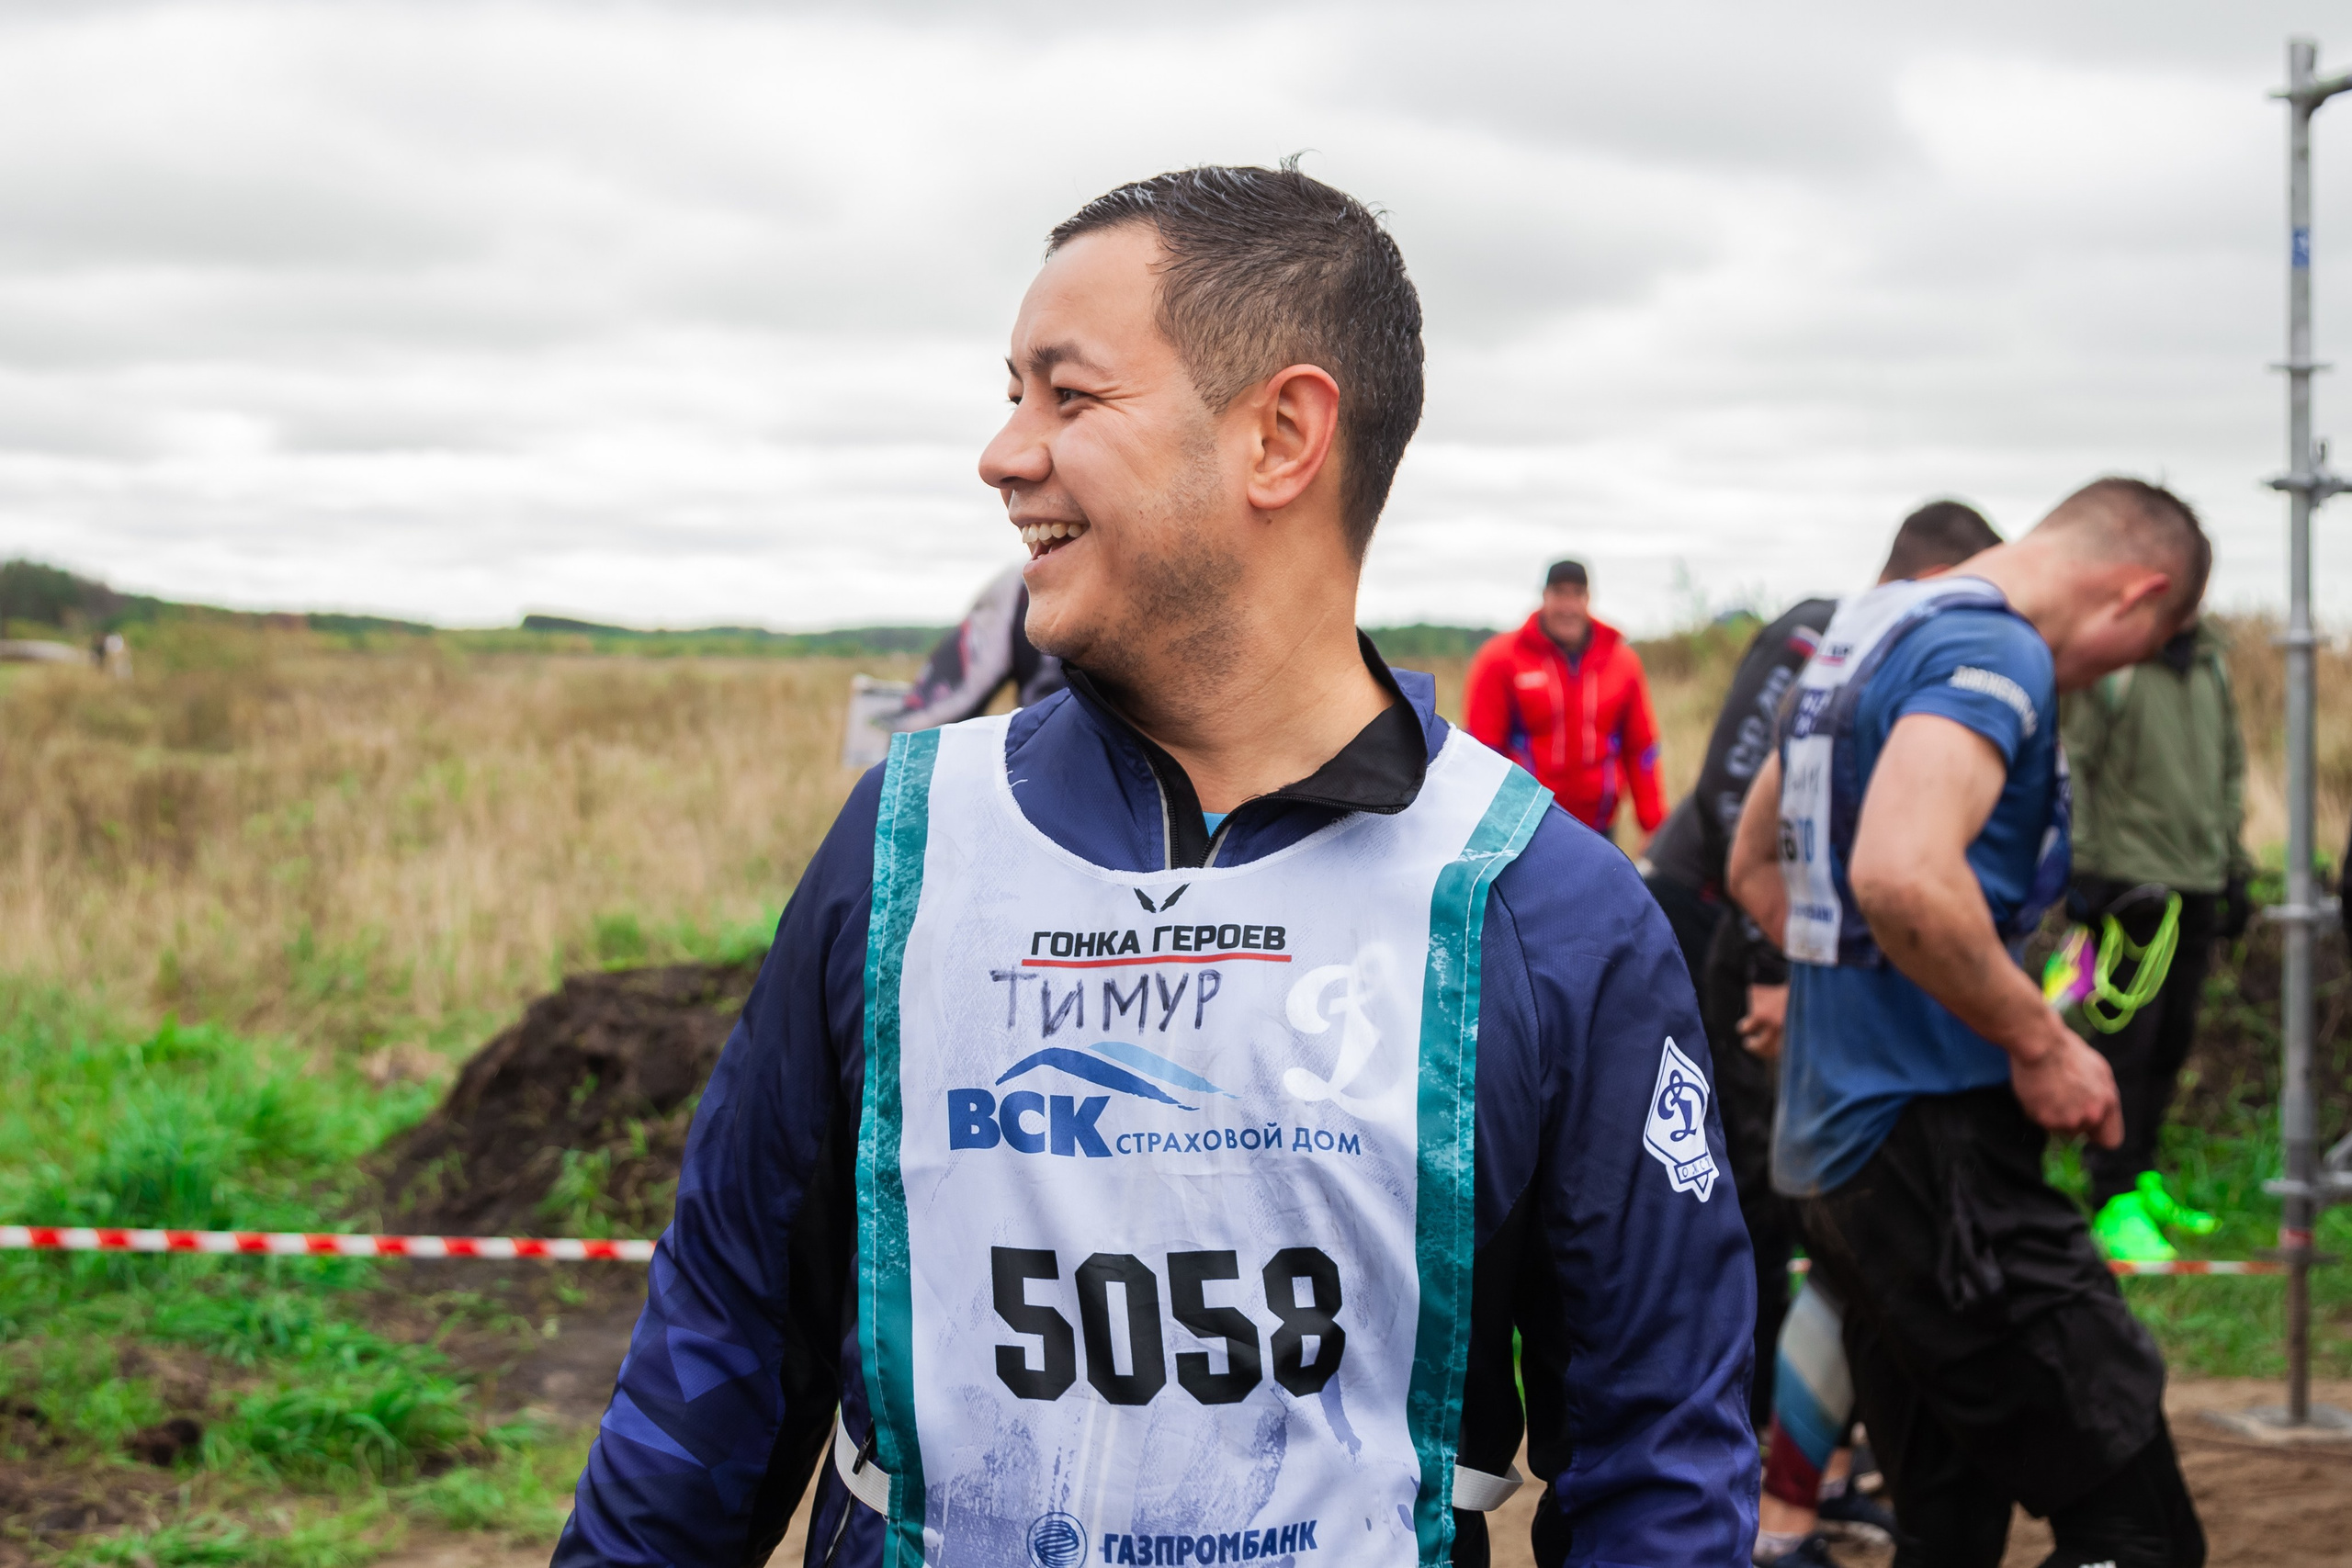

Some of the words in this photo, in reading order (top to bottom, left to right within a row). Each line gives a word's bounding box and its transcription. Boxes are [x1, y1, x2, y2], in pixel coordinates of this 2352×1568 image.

[1031, 931, 1140, 957] ГОНКА
[1152, 924, 1286, 953] ГЕРОЕВ
[990, 968, 1223, 1038] ТИМУР
[948, 1089, 1113, 1158] ВСК
[1116, 1123, 1283, 1156] СТРАХОВОЙ
[1293, 1127, 1362, 1156] ДОМ
[990, 1246, 1347, 1406] 5058
[1102, 1520, 1318, 1566] ГАЗПРОМБАНК
